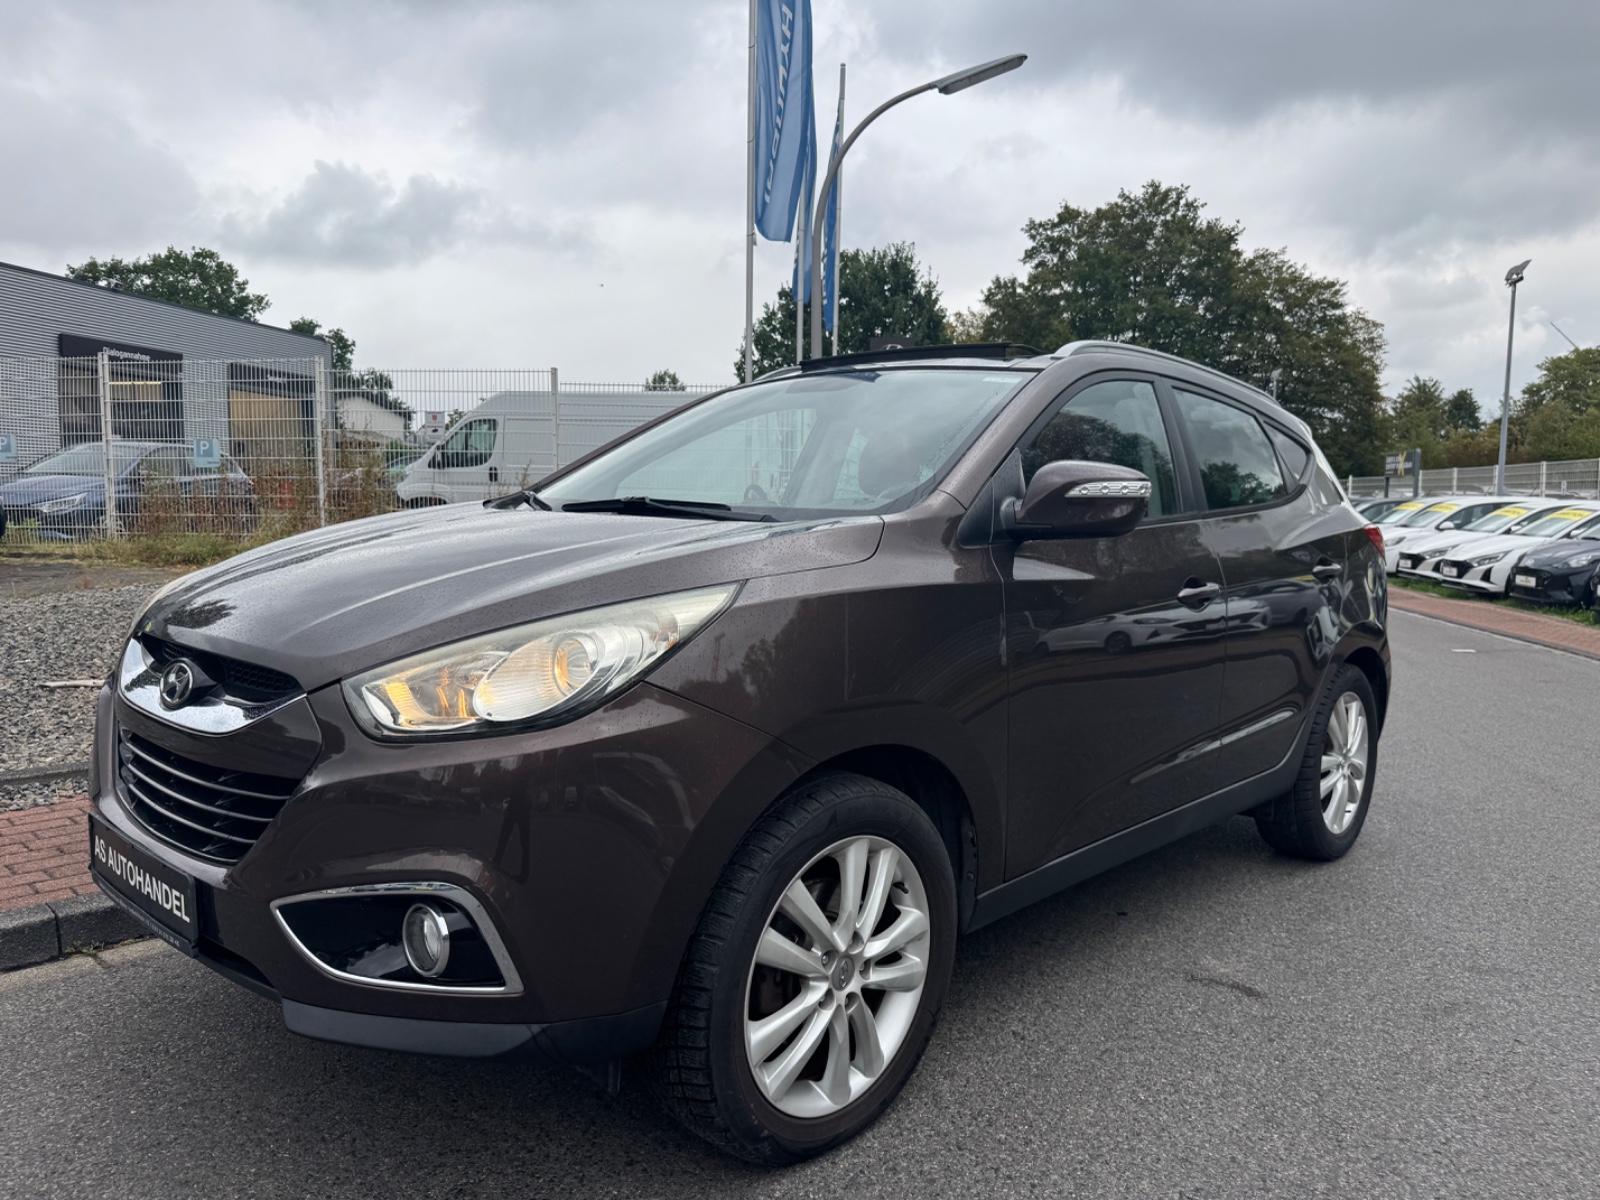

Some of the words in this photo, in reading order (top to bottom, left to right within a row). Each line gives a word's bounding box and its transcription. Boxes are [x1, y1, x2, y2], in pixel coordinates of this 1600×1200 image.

[200, 440, 210, 455] P
[94, 835, 106, 863] AS
[107, 846, 190, 924] AUTOHANDEL
